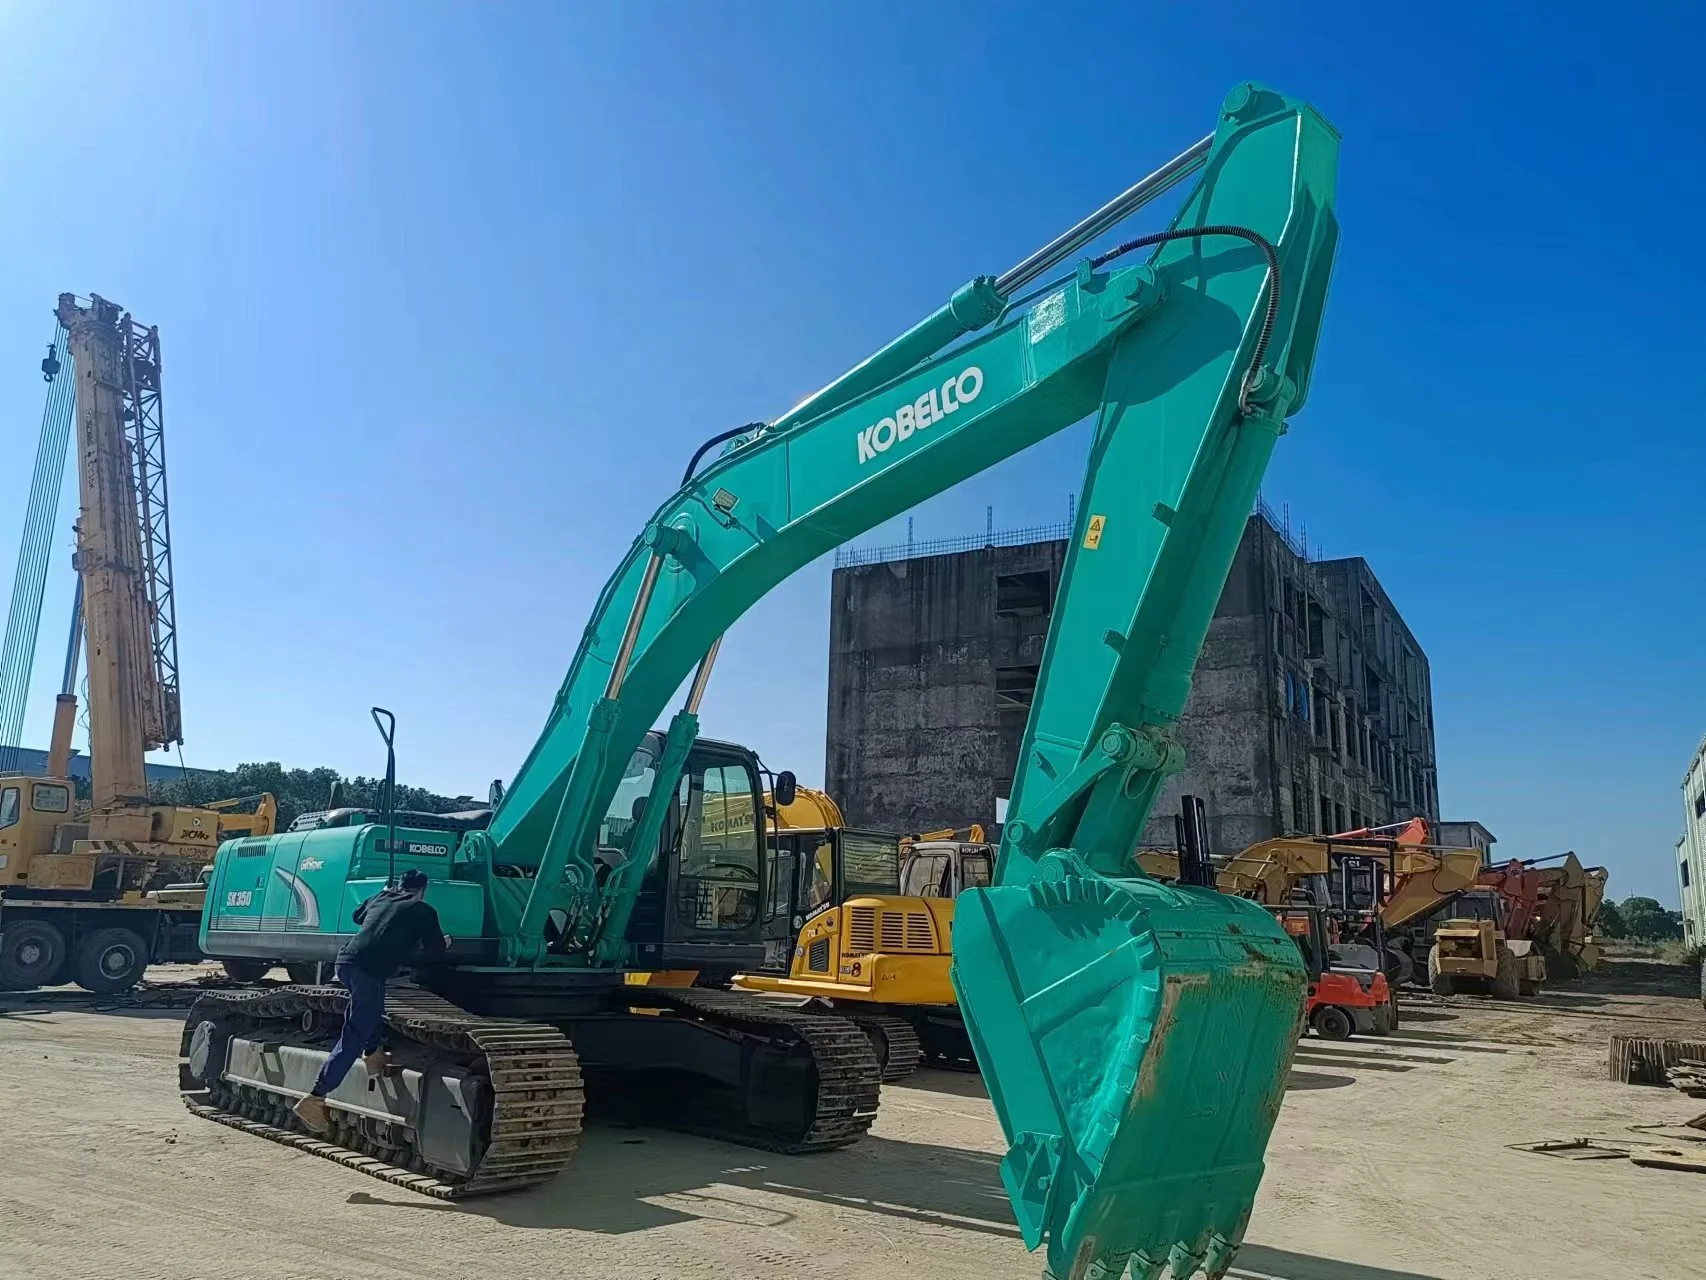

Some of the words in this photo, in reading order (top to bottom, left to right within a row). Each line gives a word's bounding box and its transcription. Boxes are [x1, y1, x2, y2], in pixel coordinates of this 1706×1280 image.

[857, 366, 984, 465] KOBELCO
[409, 844, 446, 855] KOBELCO
[227, 891, 252, 907] SK350
[805, 902, 830, 920] KOMATSU
[851, 962, 861, 977] 8
